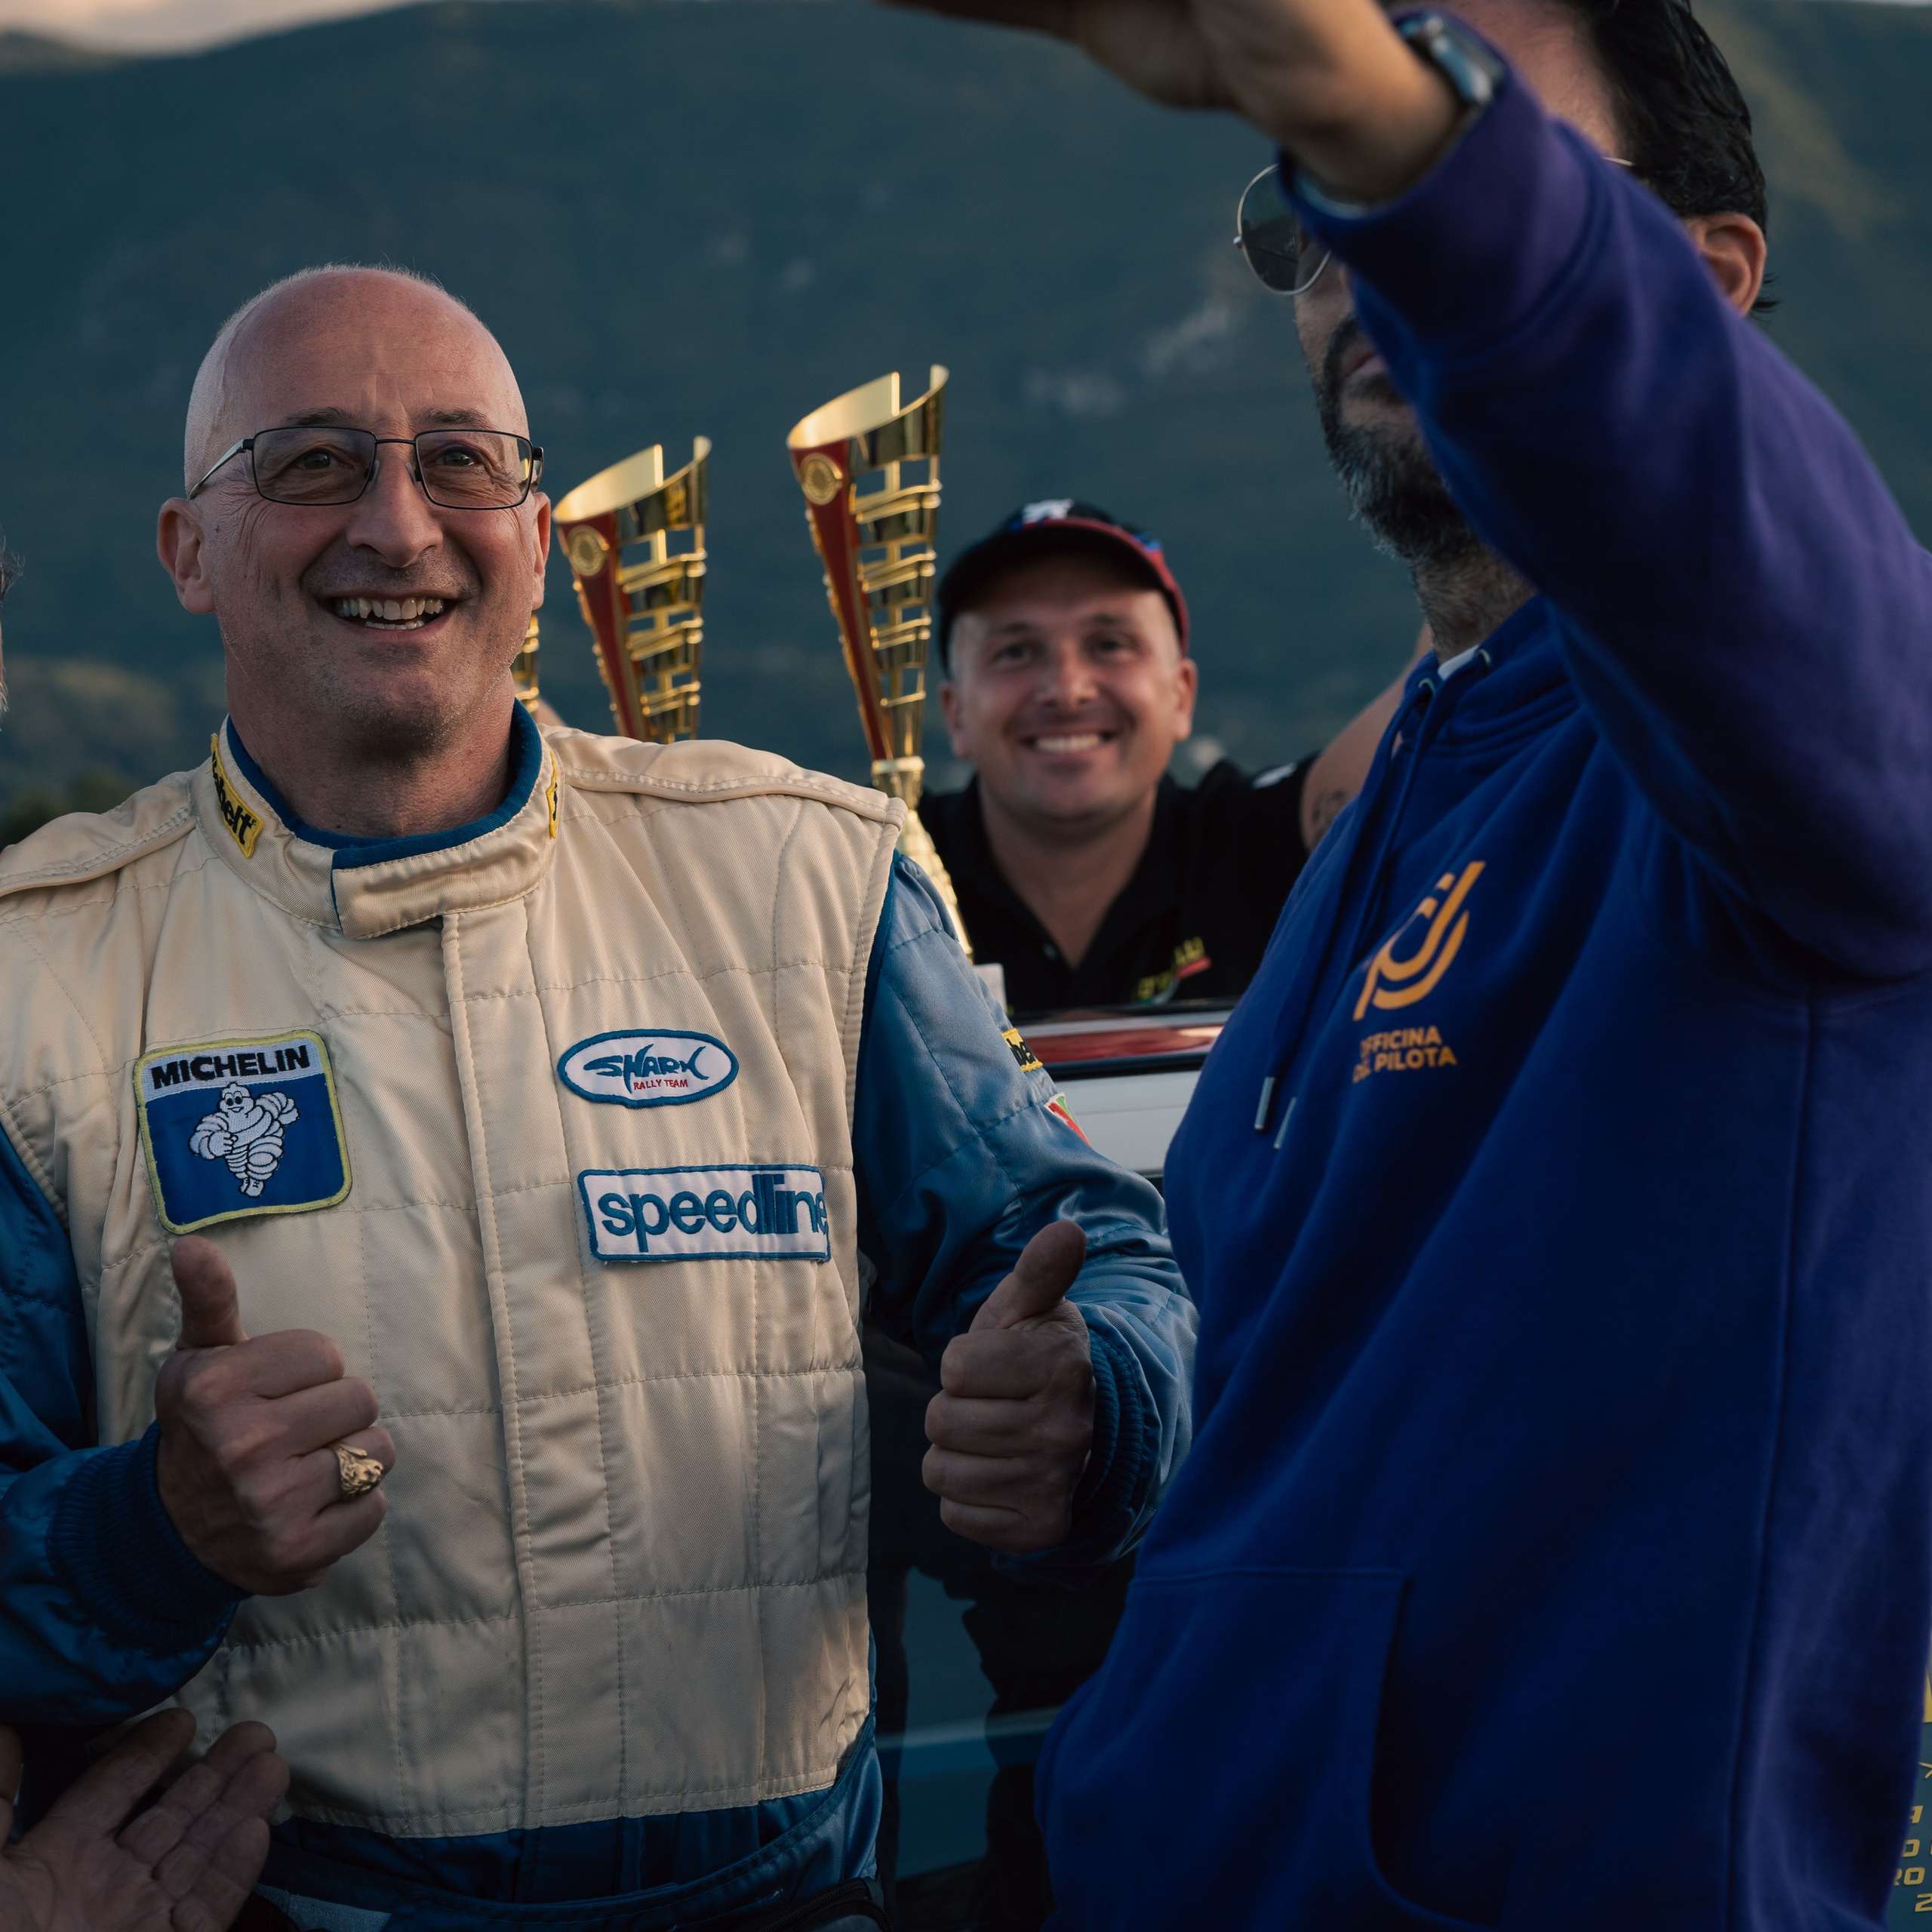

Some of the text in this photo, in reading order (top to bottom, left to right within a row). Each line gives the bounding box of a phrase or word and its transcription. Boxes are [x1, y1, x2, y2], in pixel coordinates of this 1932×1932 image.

[151, 1044, 311, 1090] MICHELIN
[583, 1044, 709, 1094] SHARK
[1374, 1045, 1458, 1073] PILOTA
[633, 1078, 688, 1091] RALLY TEAM
[598, 1173, 828, 1253] speedline
